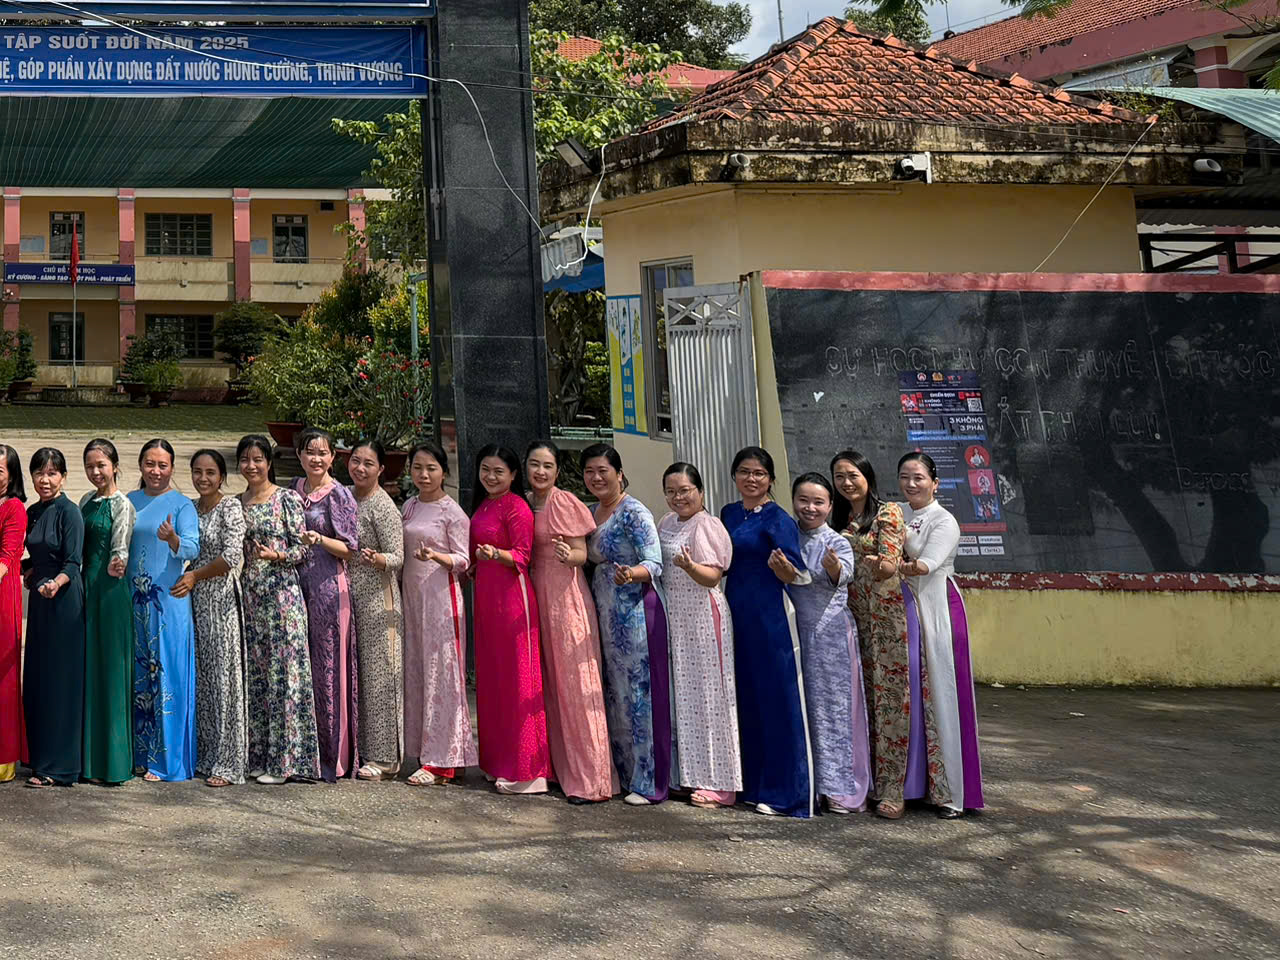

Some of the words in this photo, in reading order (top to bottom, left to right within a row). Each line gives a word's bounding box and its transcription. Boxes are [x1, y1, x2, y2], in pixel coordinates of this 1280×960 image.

[4, 33, 42, 52] TẬP
[48, 32, 101, 50] SUỐT
[105, 32, 139, 50] ĐỜI
[199, 36, 249, 50] 2025
[18, 56, 44, 80] GÓP
[48, 54, 84, 81] PHẦN
[88, 58, 112, 81] XÂY
[117, 60, 152, 84] DỰNG
[156, 55, 180, 80] ĐẤT
[184, 57, 220, 81] NƯỚC
[316, 61, 355, 86] THỊNH
[359, 60, 404, 86] VƯỢNG
